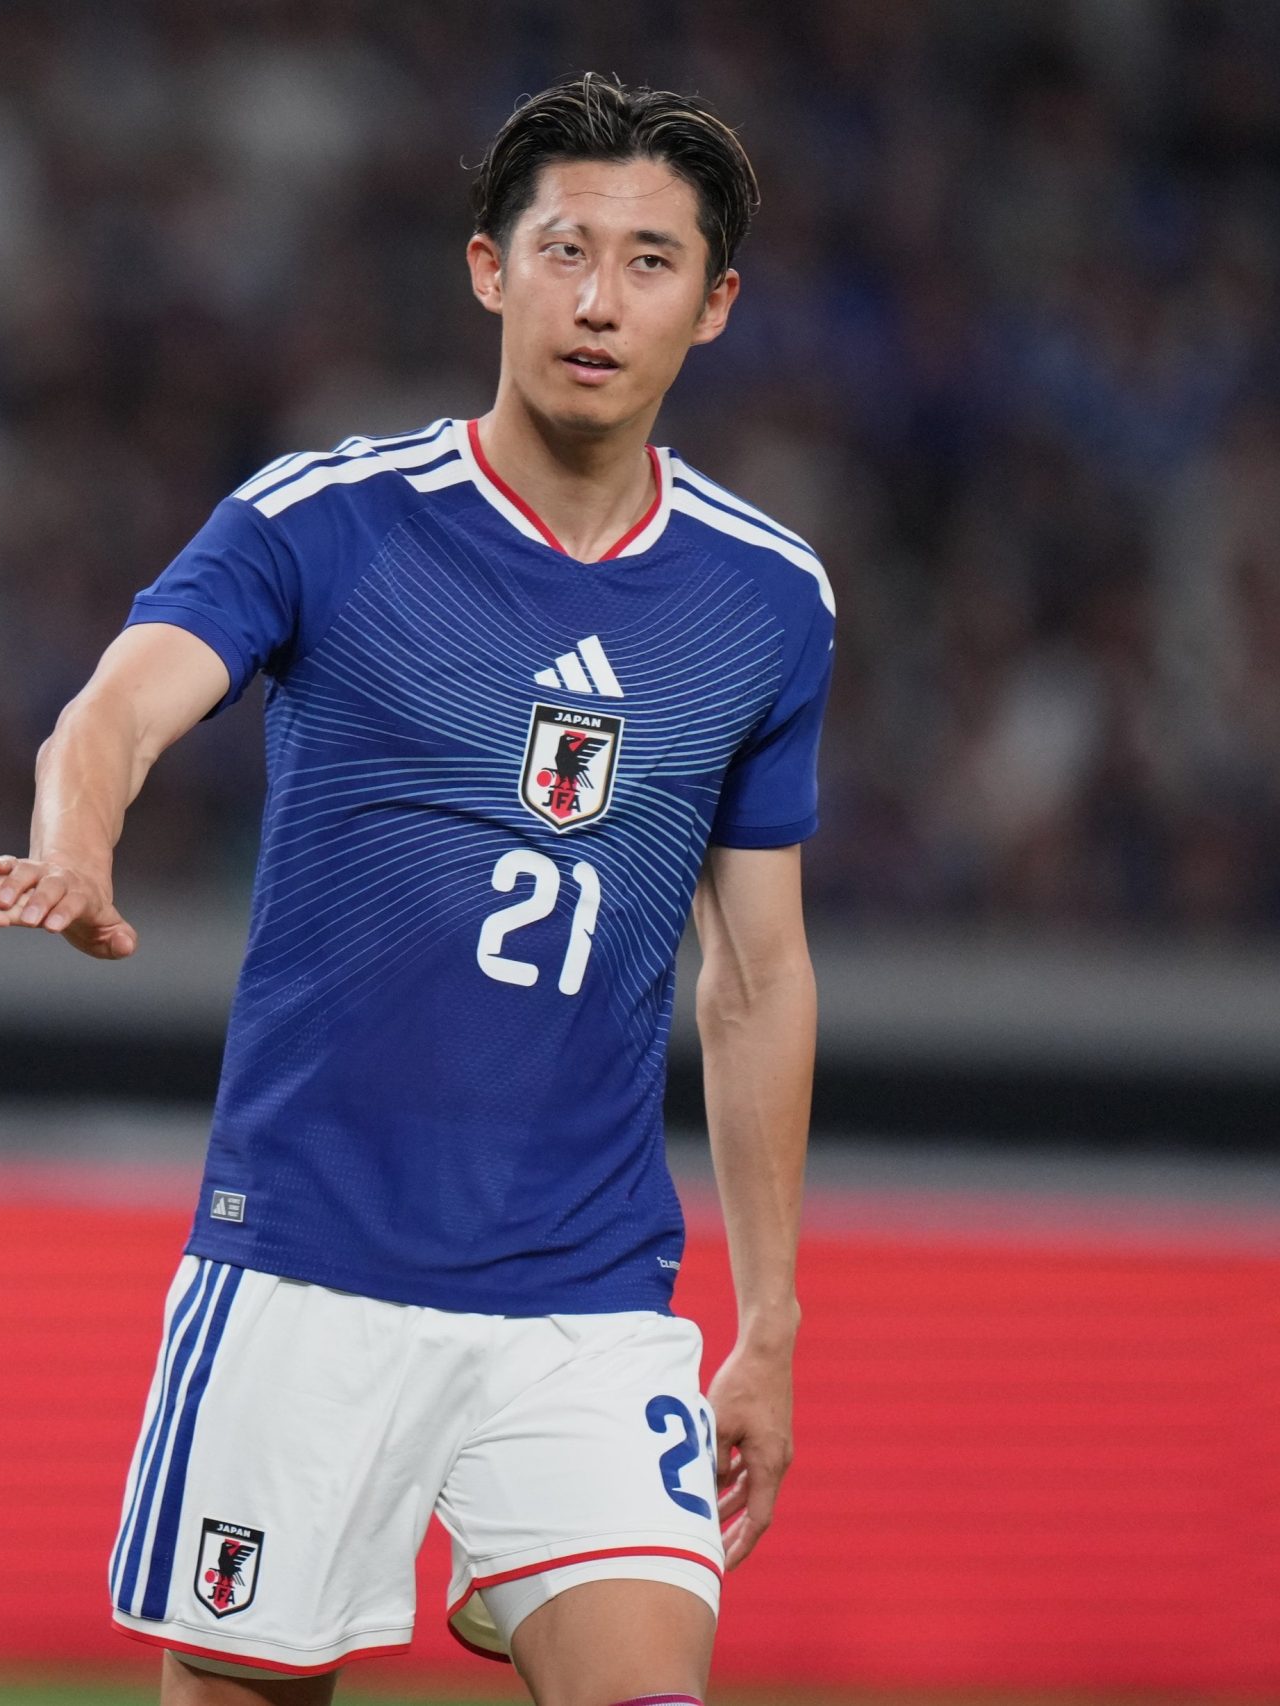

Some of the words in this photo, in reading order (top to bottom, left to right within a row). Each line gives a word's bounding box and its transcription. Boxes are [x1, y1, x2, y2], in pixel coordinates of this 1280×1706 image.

[555, 712, 601, 728] JAPAN
[541, 790, 581, 812] JFA
[477, 849, 601, 996] 21
[216, 1523, 251, 1538] JAPAN
[207, 1586, 235, 1605] JFA
